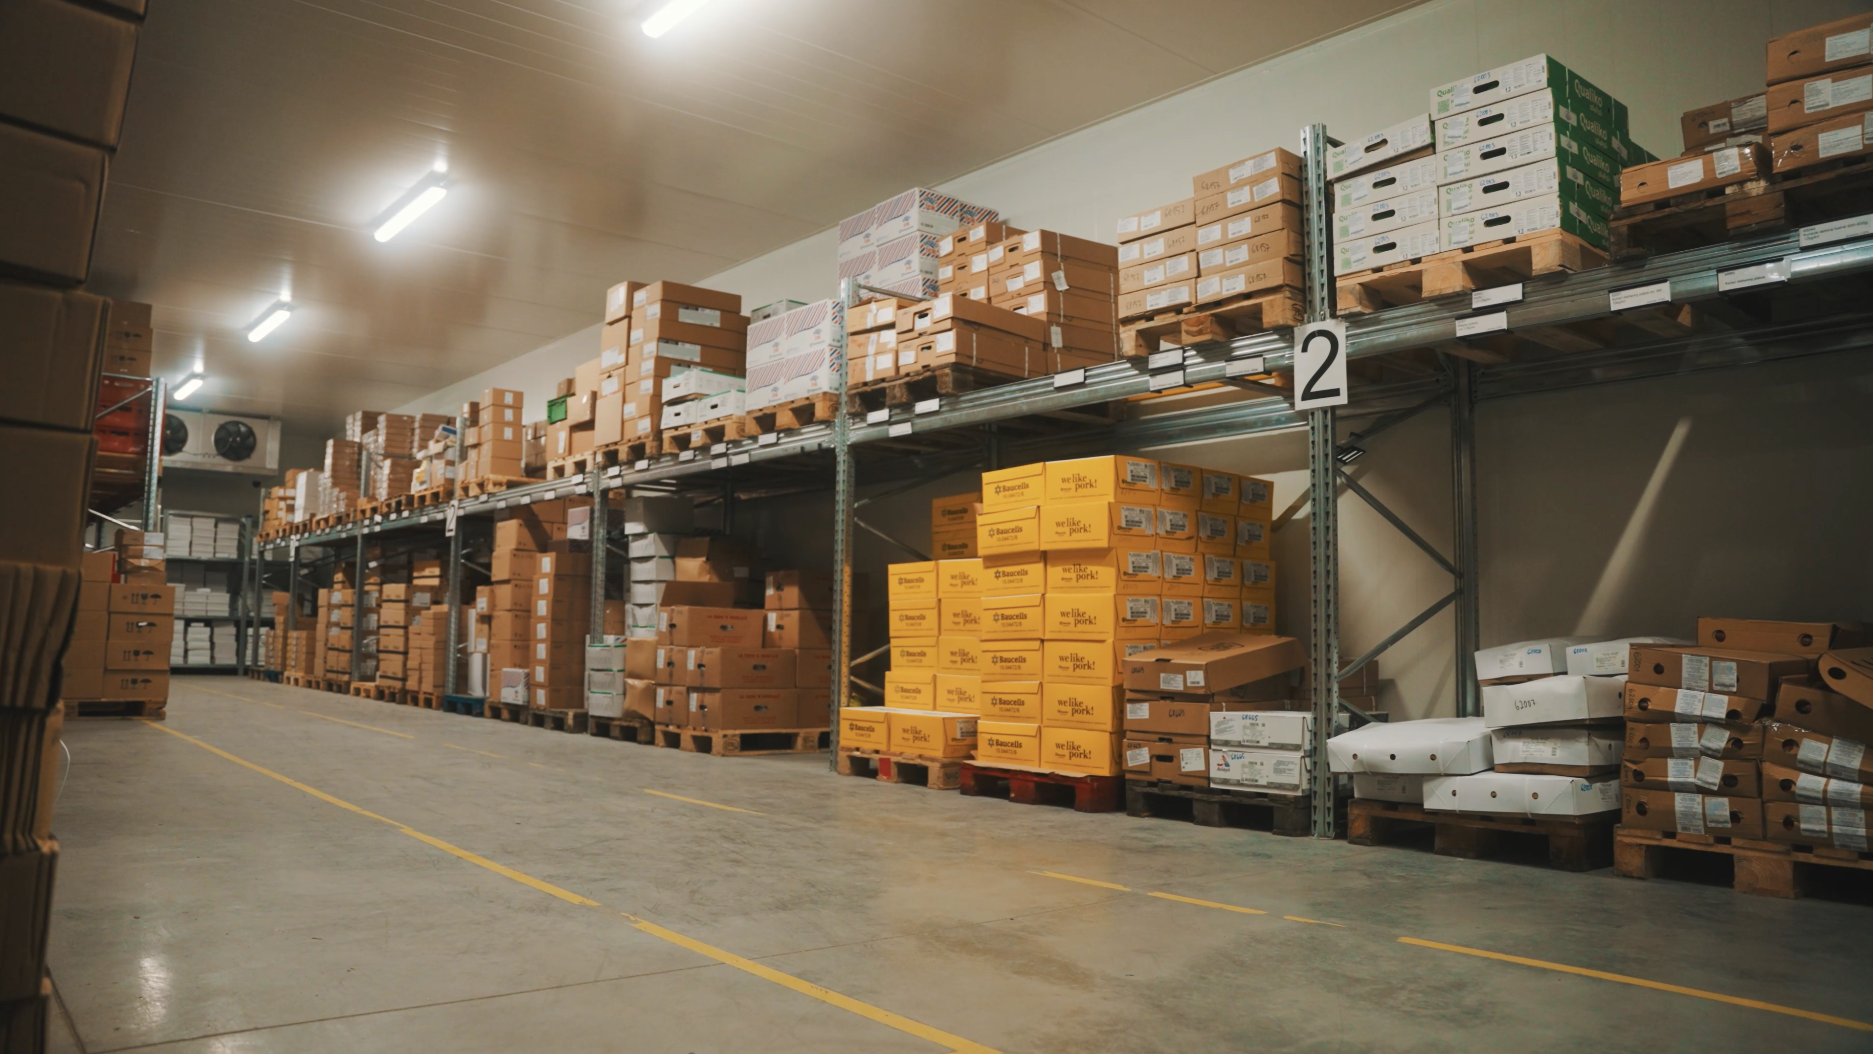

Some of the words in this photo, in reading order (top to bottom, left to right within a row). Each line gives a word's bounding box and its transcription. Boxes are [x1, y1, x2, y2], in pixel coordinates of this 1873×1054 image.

[1574, 79, 1603, 106] Qualiko
[1579, 112, 1607, 140] Qualiko
[1582, 147, 1610, 173] Qualiko
[1585, 180, 1612, 207] Qualiko
[1586, 211, 1608, 238] Qualik
[1301, 329, 1341, 401] 2
[1061, 476, 1071, 484] we
[1072, 473, 1087, 483] like
[1002, 482, 1029, 492] Baucells
[1075, 479, 1097, 492] pork!
[447, 504, 455, 532] 2
[1055, 520, 1065, 528] we
[1066, 517, 1081, 527] like
[996, 525, 1023, 535] Baucells
[1069, 523, 1091, 537] pork!
[1001, 569, 1028, 578] Baucells
[1073, 564, 1088, 573] like
[958, 572, 971, 580] like
[1076, 570, 1098, 583] pork!
[960, 578, 978, 588] pork!
[961, 610, 973, 618] like
[1001, 612, 1027, 620] Baucells
[1071, 608, 1086, 618] like
[963, 616, 980, 627] pork!
[1074, 616, 1096, 628] pork!
[958, 649, 970, 657] like
[1070, 653, 1085, 663] like
[960, 656, 978, 665] pork!
[999, 656, 1026, 664] Baucells
[1073, 661, 1095, 672] pork!
[955, 687, 967, 696] like
[957, 695, 975, 703] pork!
[999, 698, 1025, 706] Baucells
[1057, 699, 1068, 707] we
[1069, 697, 1084, 707] like
[1515, 699, 1536, 711] 62007
[1071, 706, 1094, 717] pork!
[910, 726, 922, 735] like
[912, 735, 930, 743] pork!
[995, 739, 1022, 748] Baucells
[1055, 742, 1066, 750] we
[1066, 741, 1081, 751] like
[1069, 749, 1091, 760] pork!
